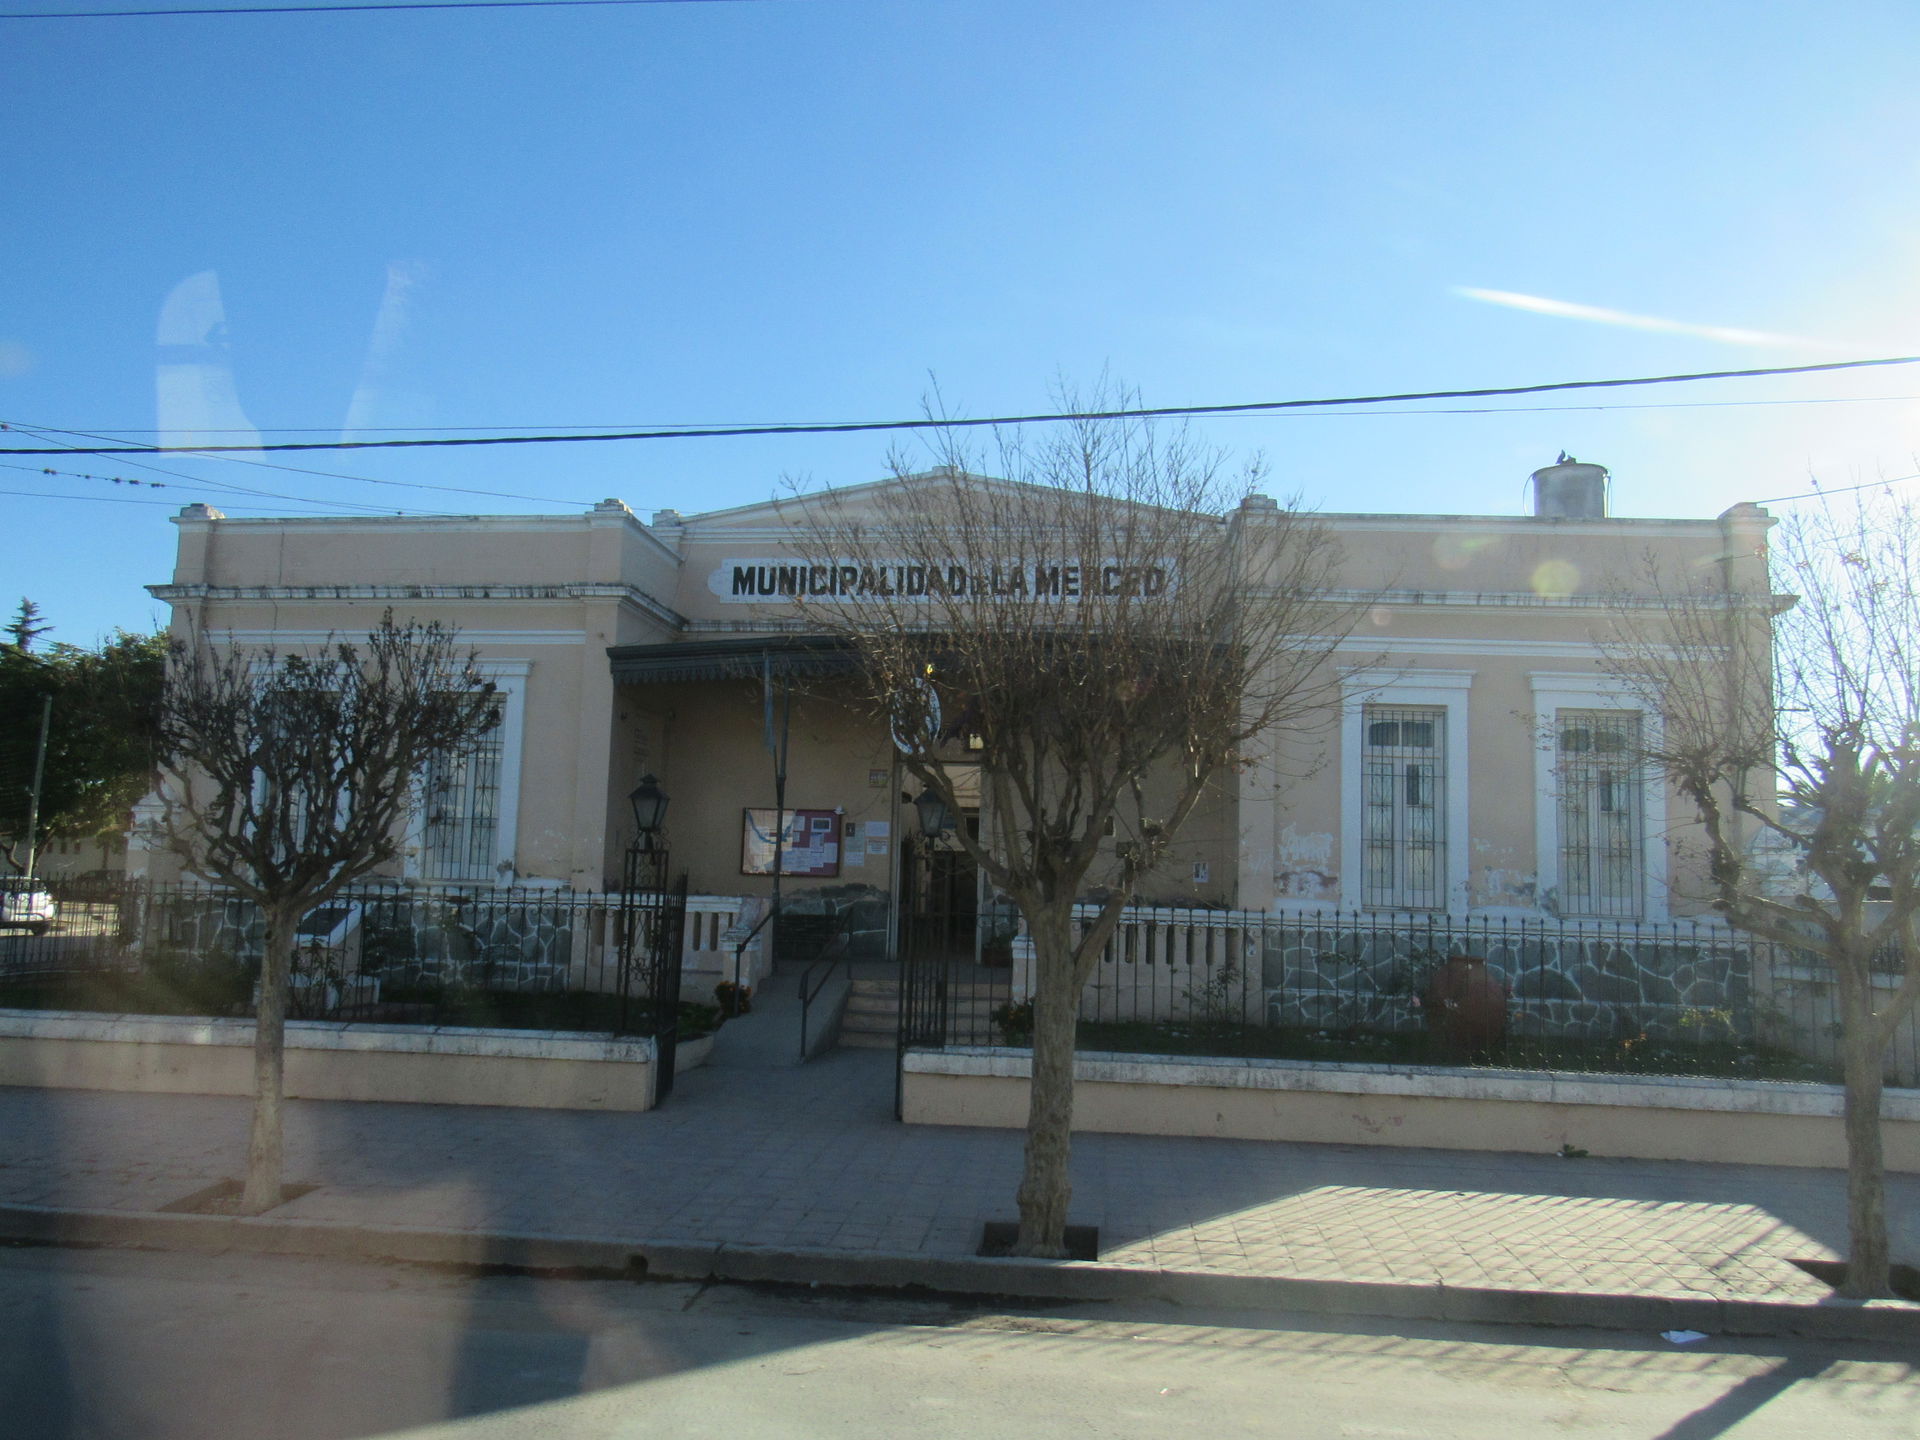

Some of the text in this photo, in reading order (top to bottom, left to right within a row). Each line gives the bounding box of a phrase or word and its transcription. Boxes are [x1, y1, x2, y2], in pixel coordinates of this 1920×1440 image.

[732, 566, 967, 596] MUNICIPALIDAD
[991, 566, 1029, 596] LA
[1034, 566, 1165, 596] MECD
